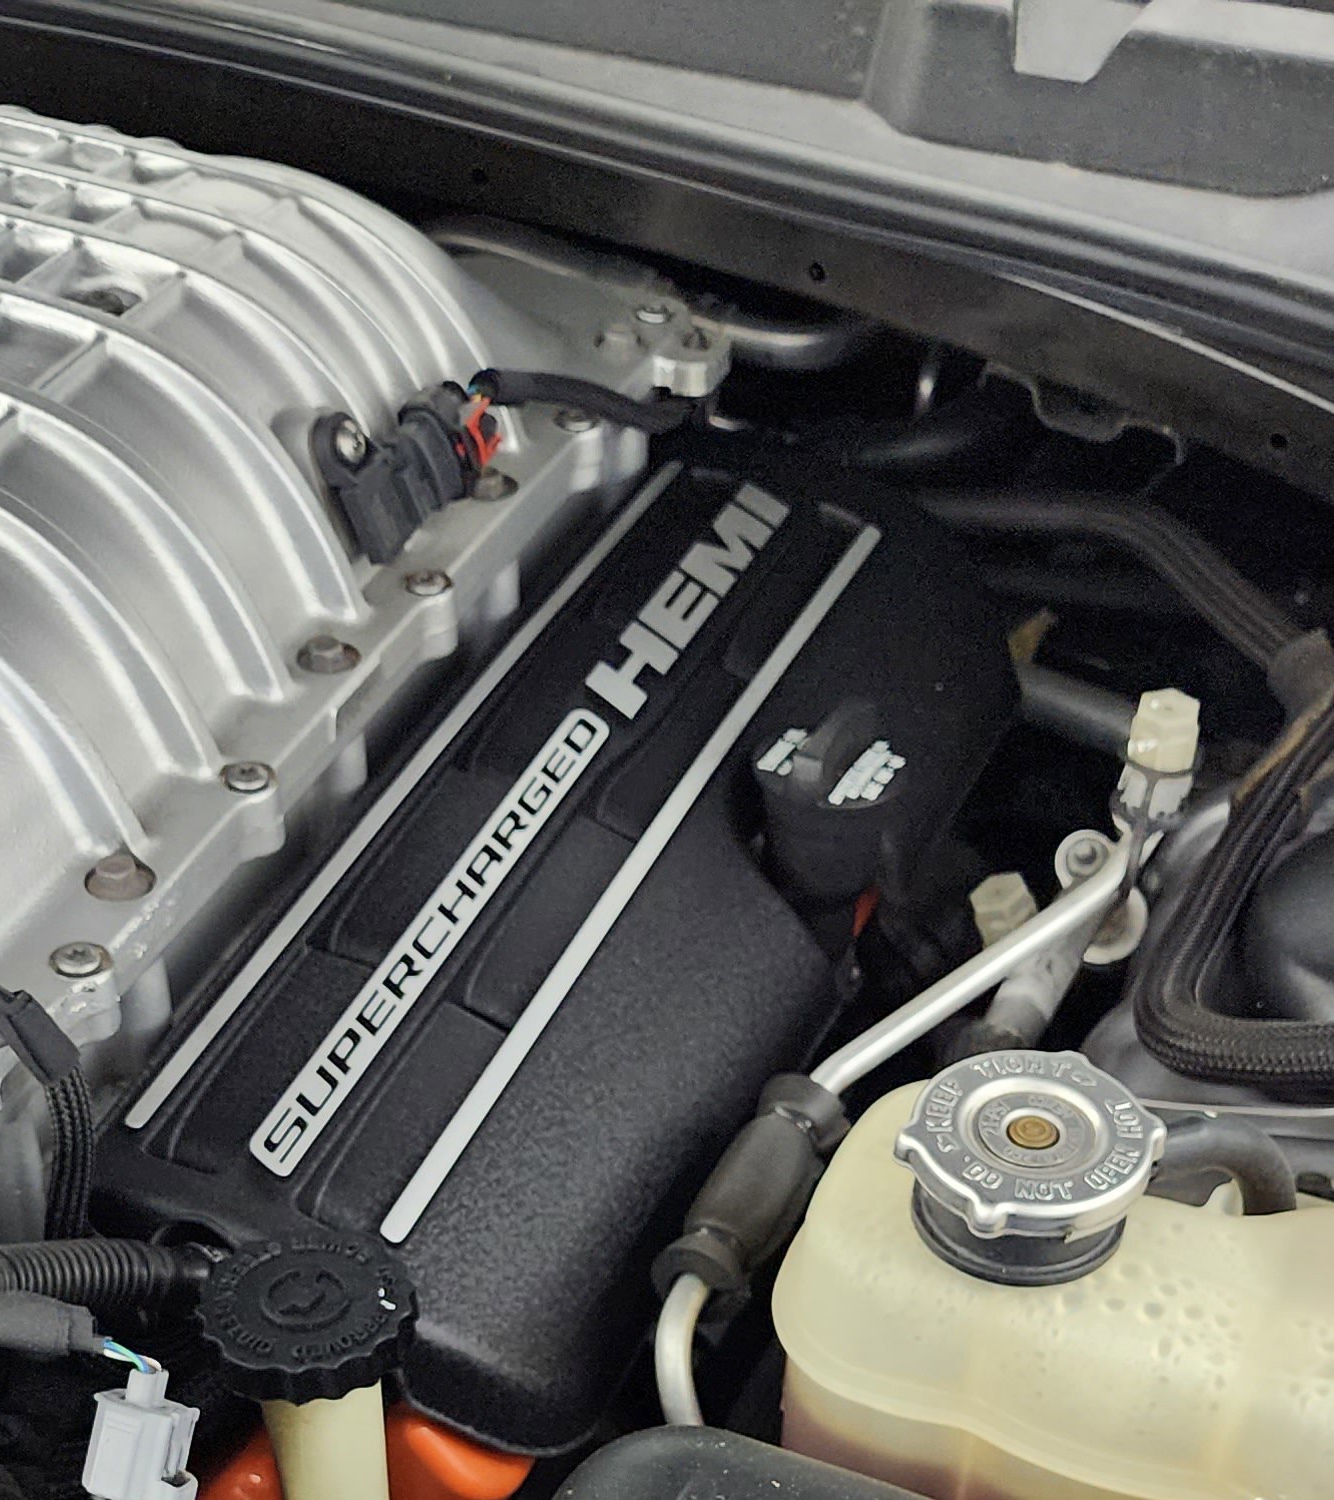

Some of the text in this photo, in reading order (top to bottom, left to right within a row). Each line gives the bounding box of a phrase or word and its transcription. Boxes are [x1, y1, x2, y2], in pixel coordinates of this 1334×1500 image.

[261, 483, 792, 1166] SUPERCHARGED HEMI
[923, 1077, 965, 1134] KEEP
[1102, 1098, 1145, 1140] HOT
[961, 1162, 1004, 1191] DO
[1013, 1177, 1075, 1202] NOT
[1082, 1144, 1142, 1193] OPEN
